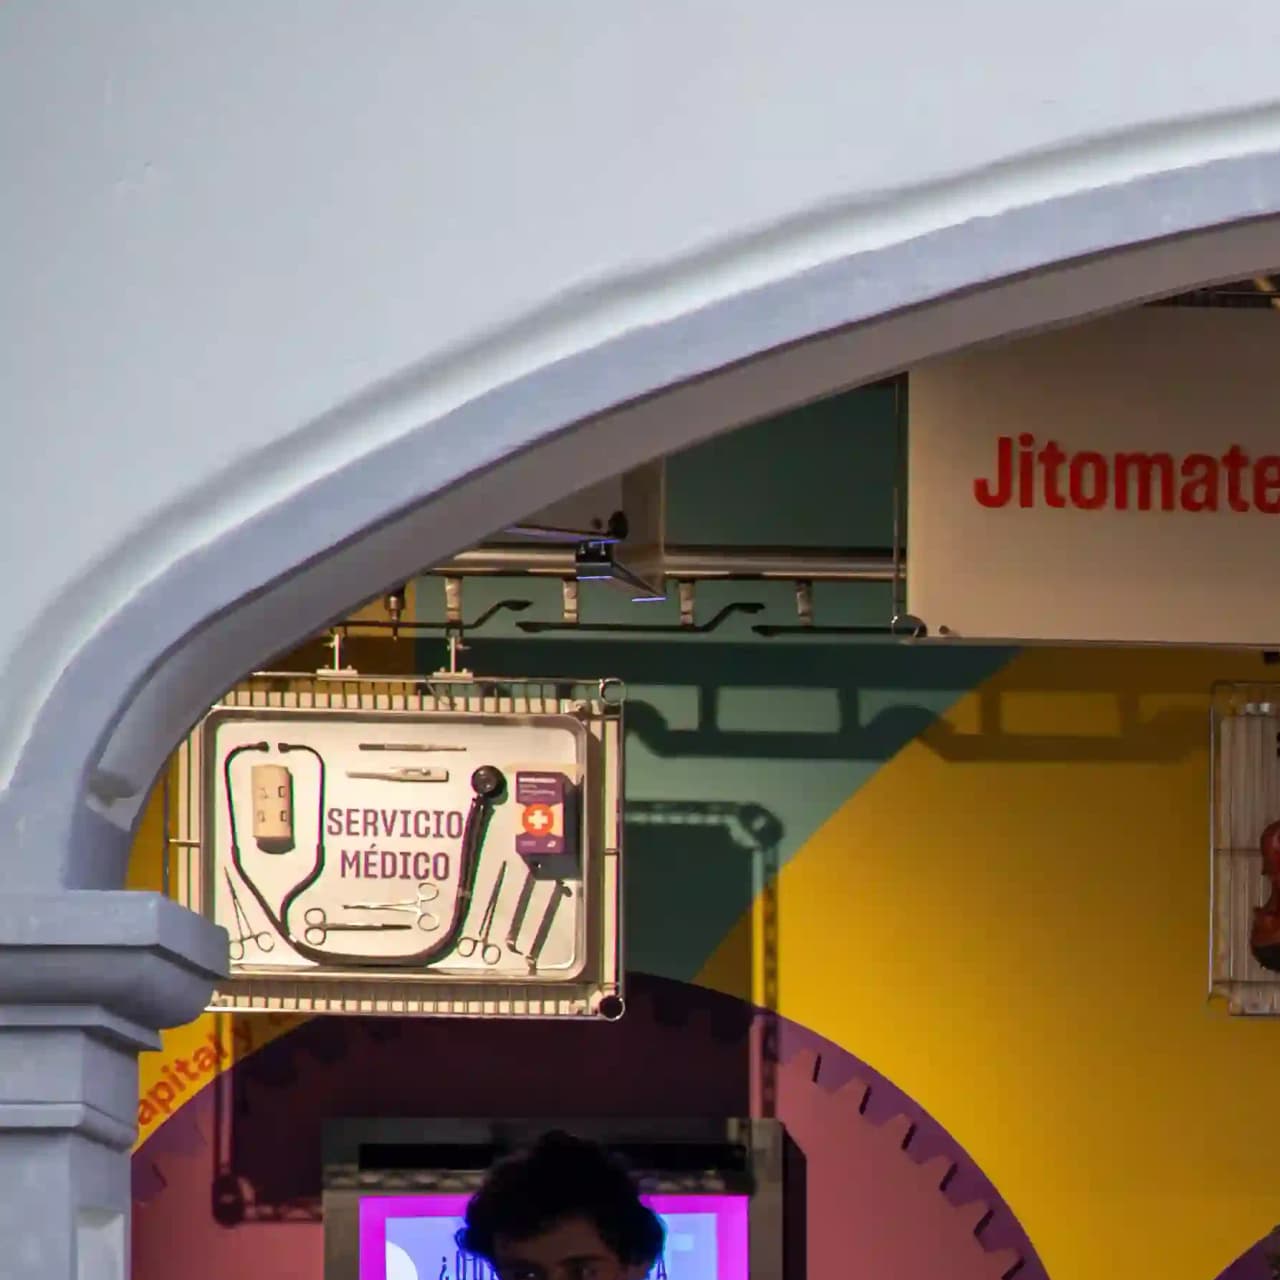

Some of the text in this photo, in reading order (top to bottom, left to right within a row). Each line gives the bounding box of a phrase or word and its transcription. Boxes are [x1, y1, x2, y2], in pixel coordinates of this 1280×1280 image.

[326, 807, 464, 840] SERVICIO
[340, 843, 450, 881] MÉDICO
[137, 1033, 228, 1127] apital
